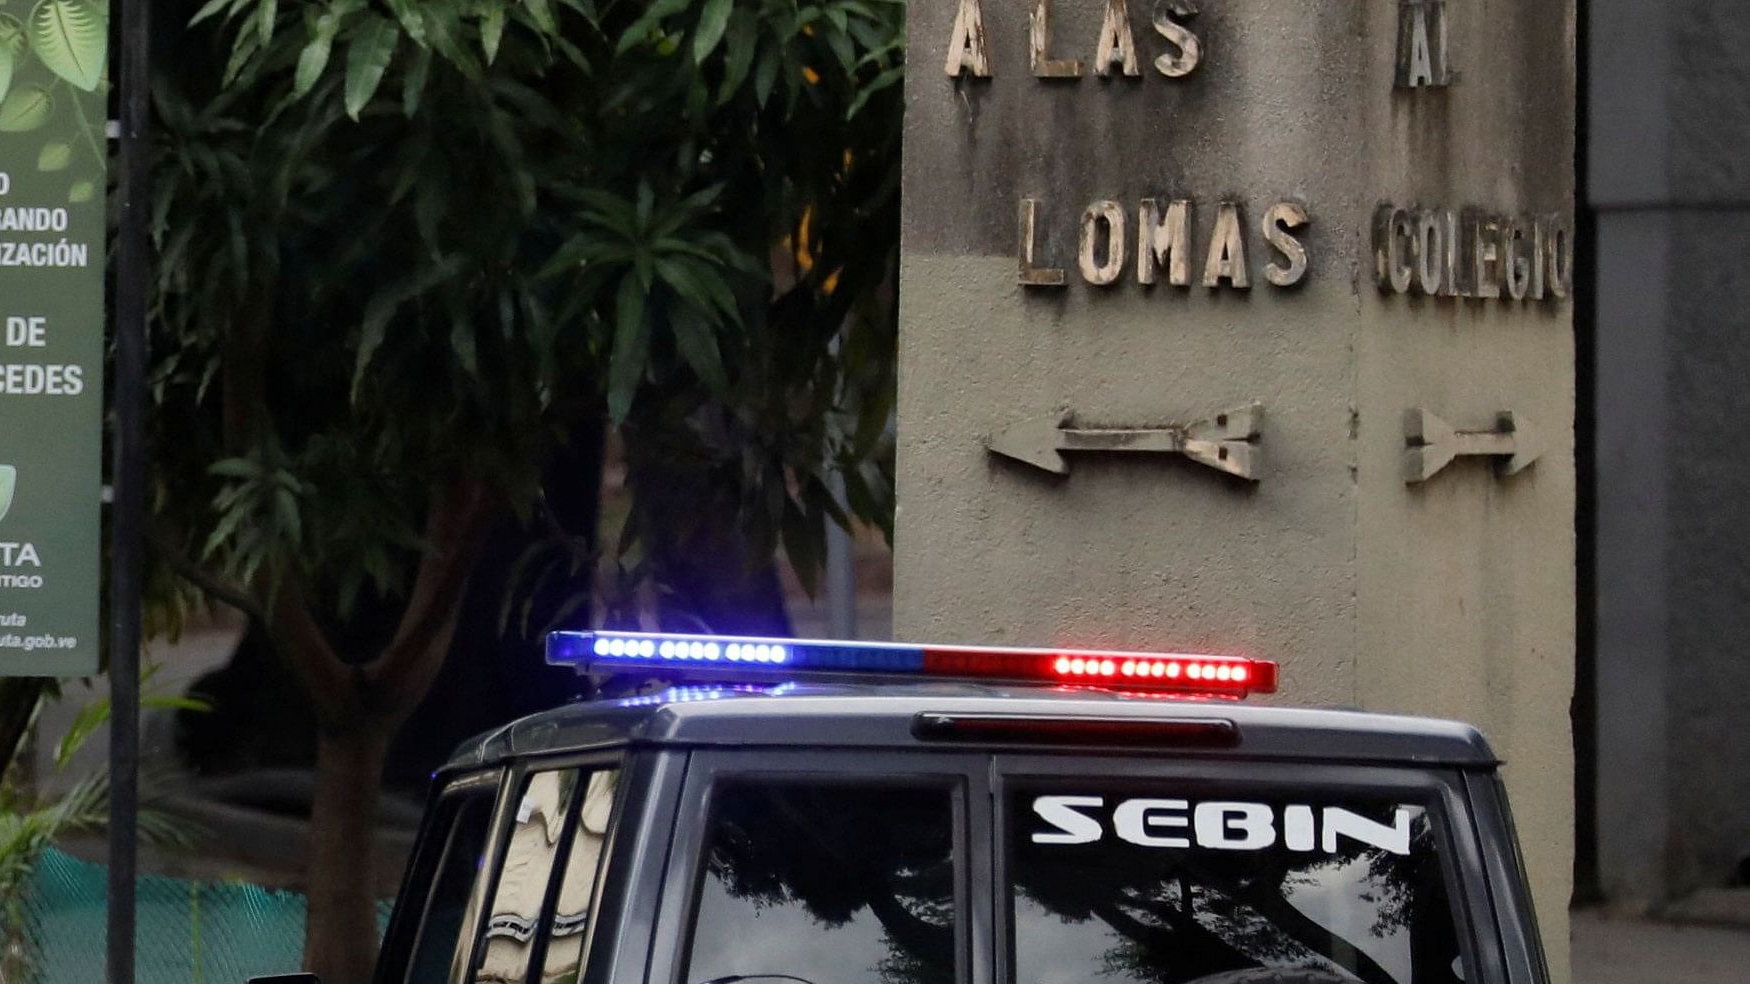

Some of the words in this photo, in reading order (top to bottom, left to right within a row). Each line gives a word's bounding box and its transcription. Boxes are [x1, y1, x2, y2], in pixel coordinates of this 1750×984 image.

[944, 0, 992, 77] A
[1029, 0, 1200, 77] LAS
[1018, 198, 1308, 288] LOMAS
[1372, 202, 1573, 300] COLEGIO
[6, 317, 47, 347] DE
[1032, 795, 1411, 856] SEBIN
